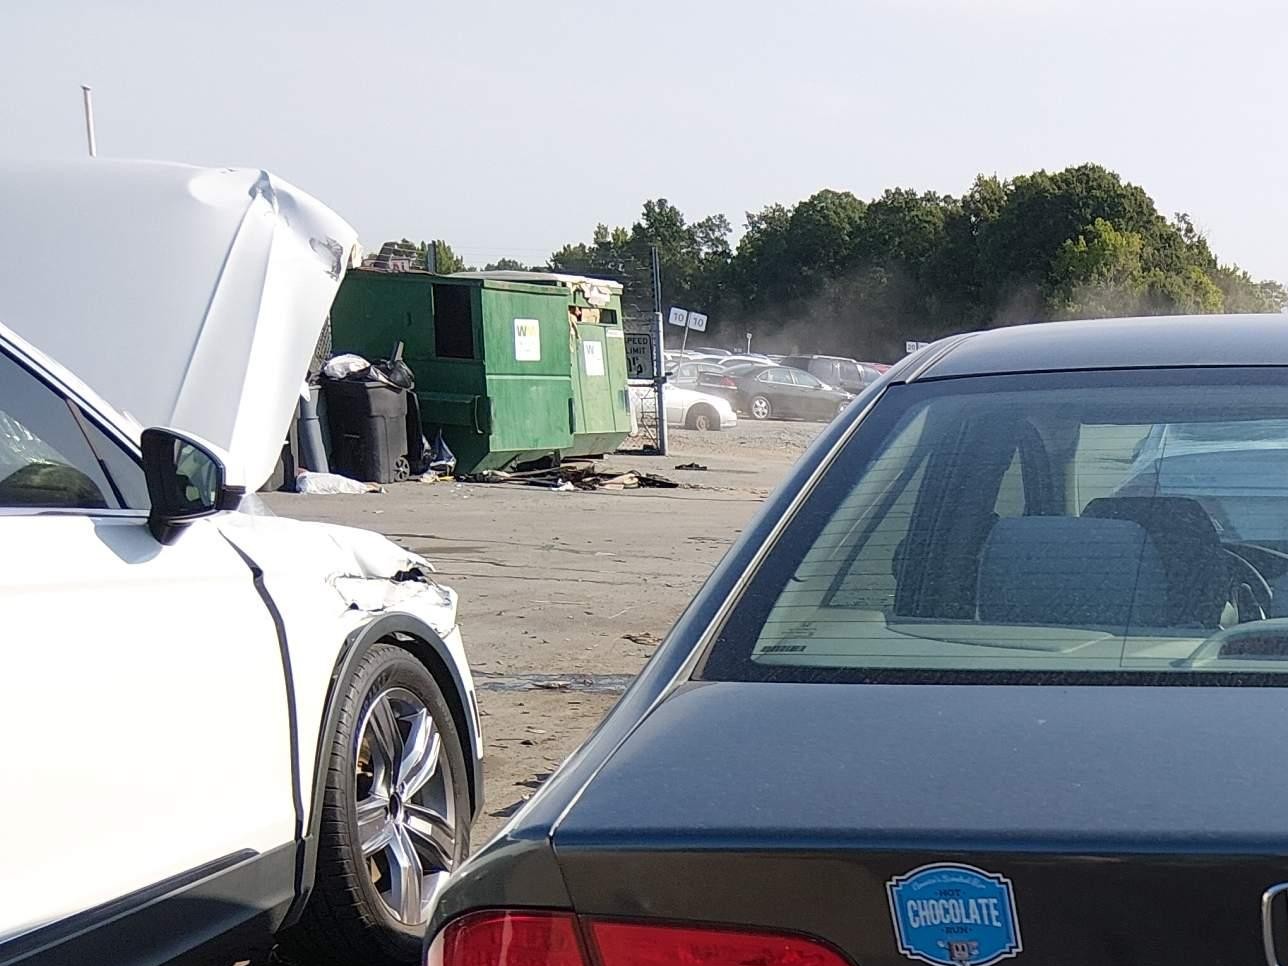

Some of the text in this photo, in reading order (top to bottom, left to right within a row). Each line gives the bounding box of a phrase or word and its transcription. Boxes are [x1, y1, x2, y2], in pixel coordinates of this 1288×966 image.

[673, 312, 704, 327] 10 10
[906, 898, 1002, 929] CHOCOLATE
